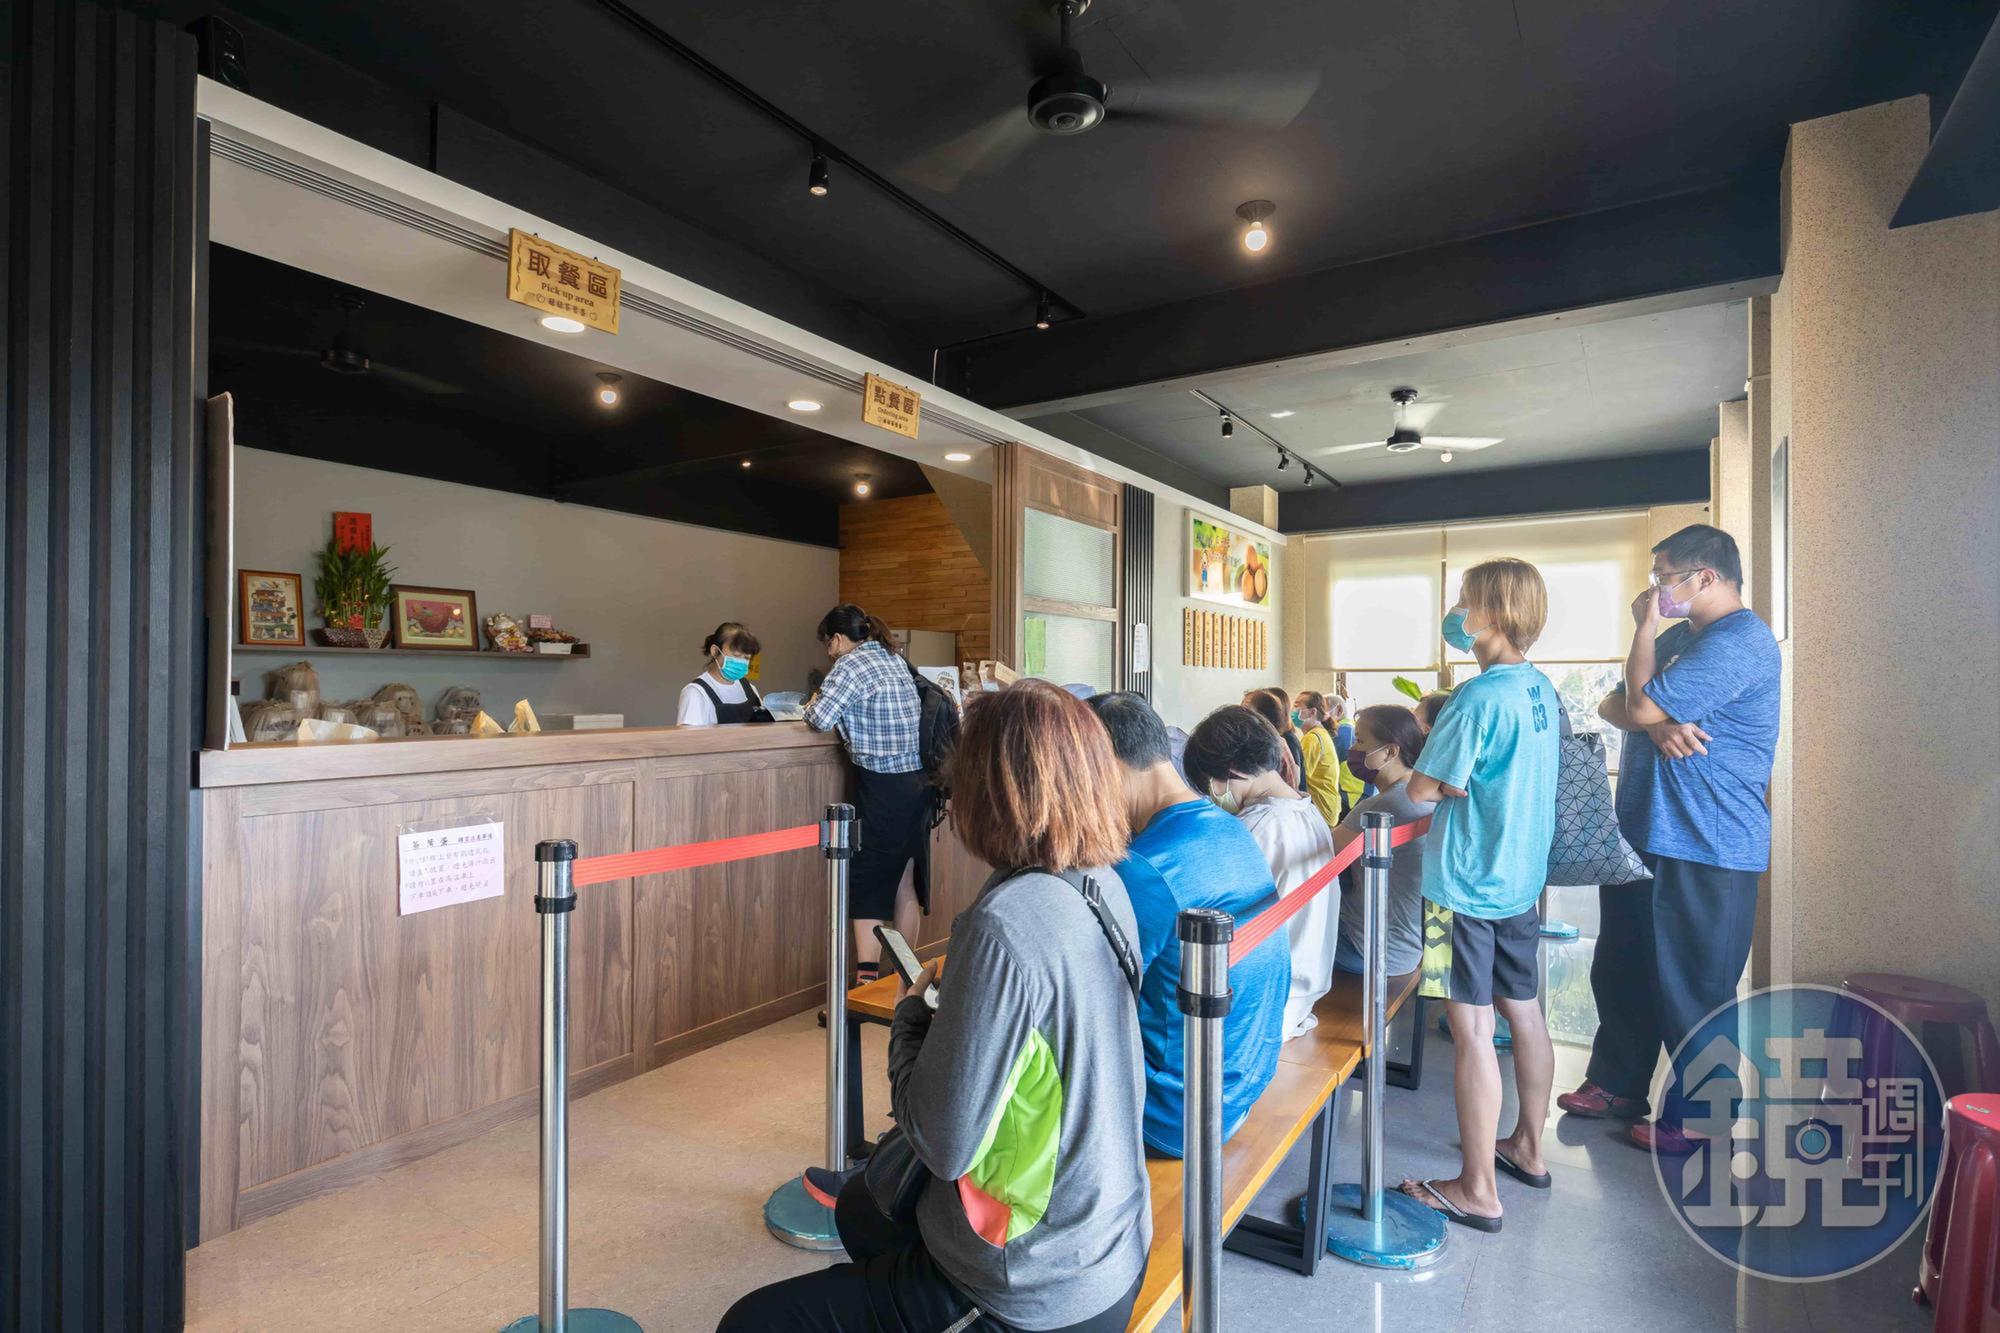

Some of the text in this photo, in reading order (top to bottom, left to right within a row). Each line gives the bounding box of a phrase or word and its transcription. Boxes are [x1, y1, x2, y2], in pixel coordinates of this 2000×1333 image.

[527, 248, 608, 299] 取餐區
[541, 281, 594, 307] Pick up area
[873, 385, 915, 416] 點餐區
[1526, 685, 1541, 700] W
